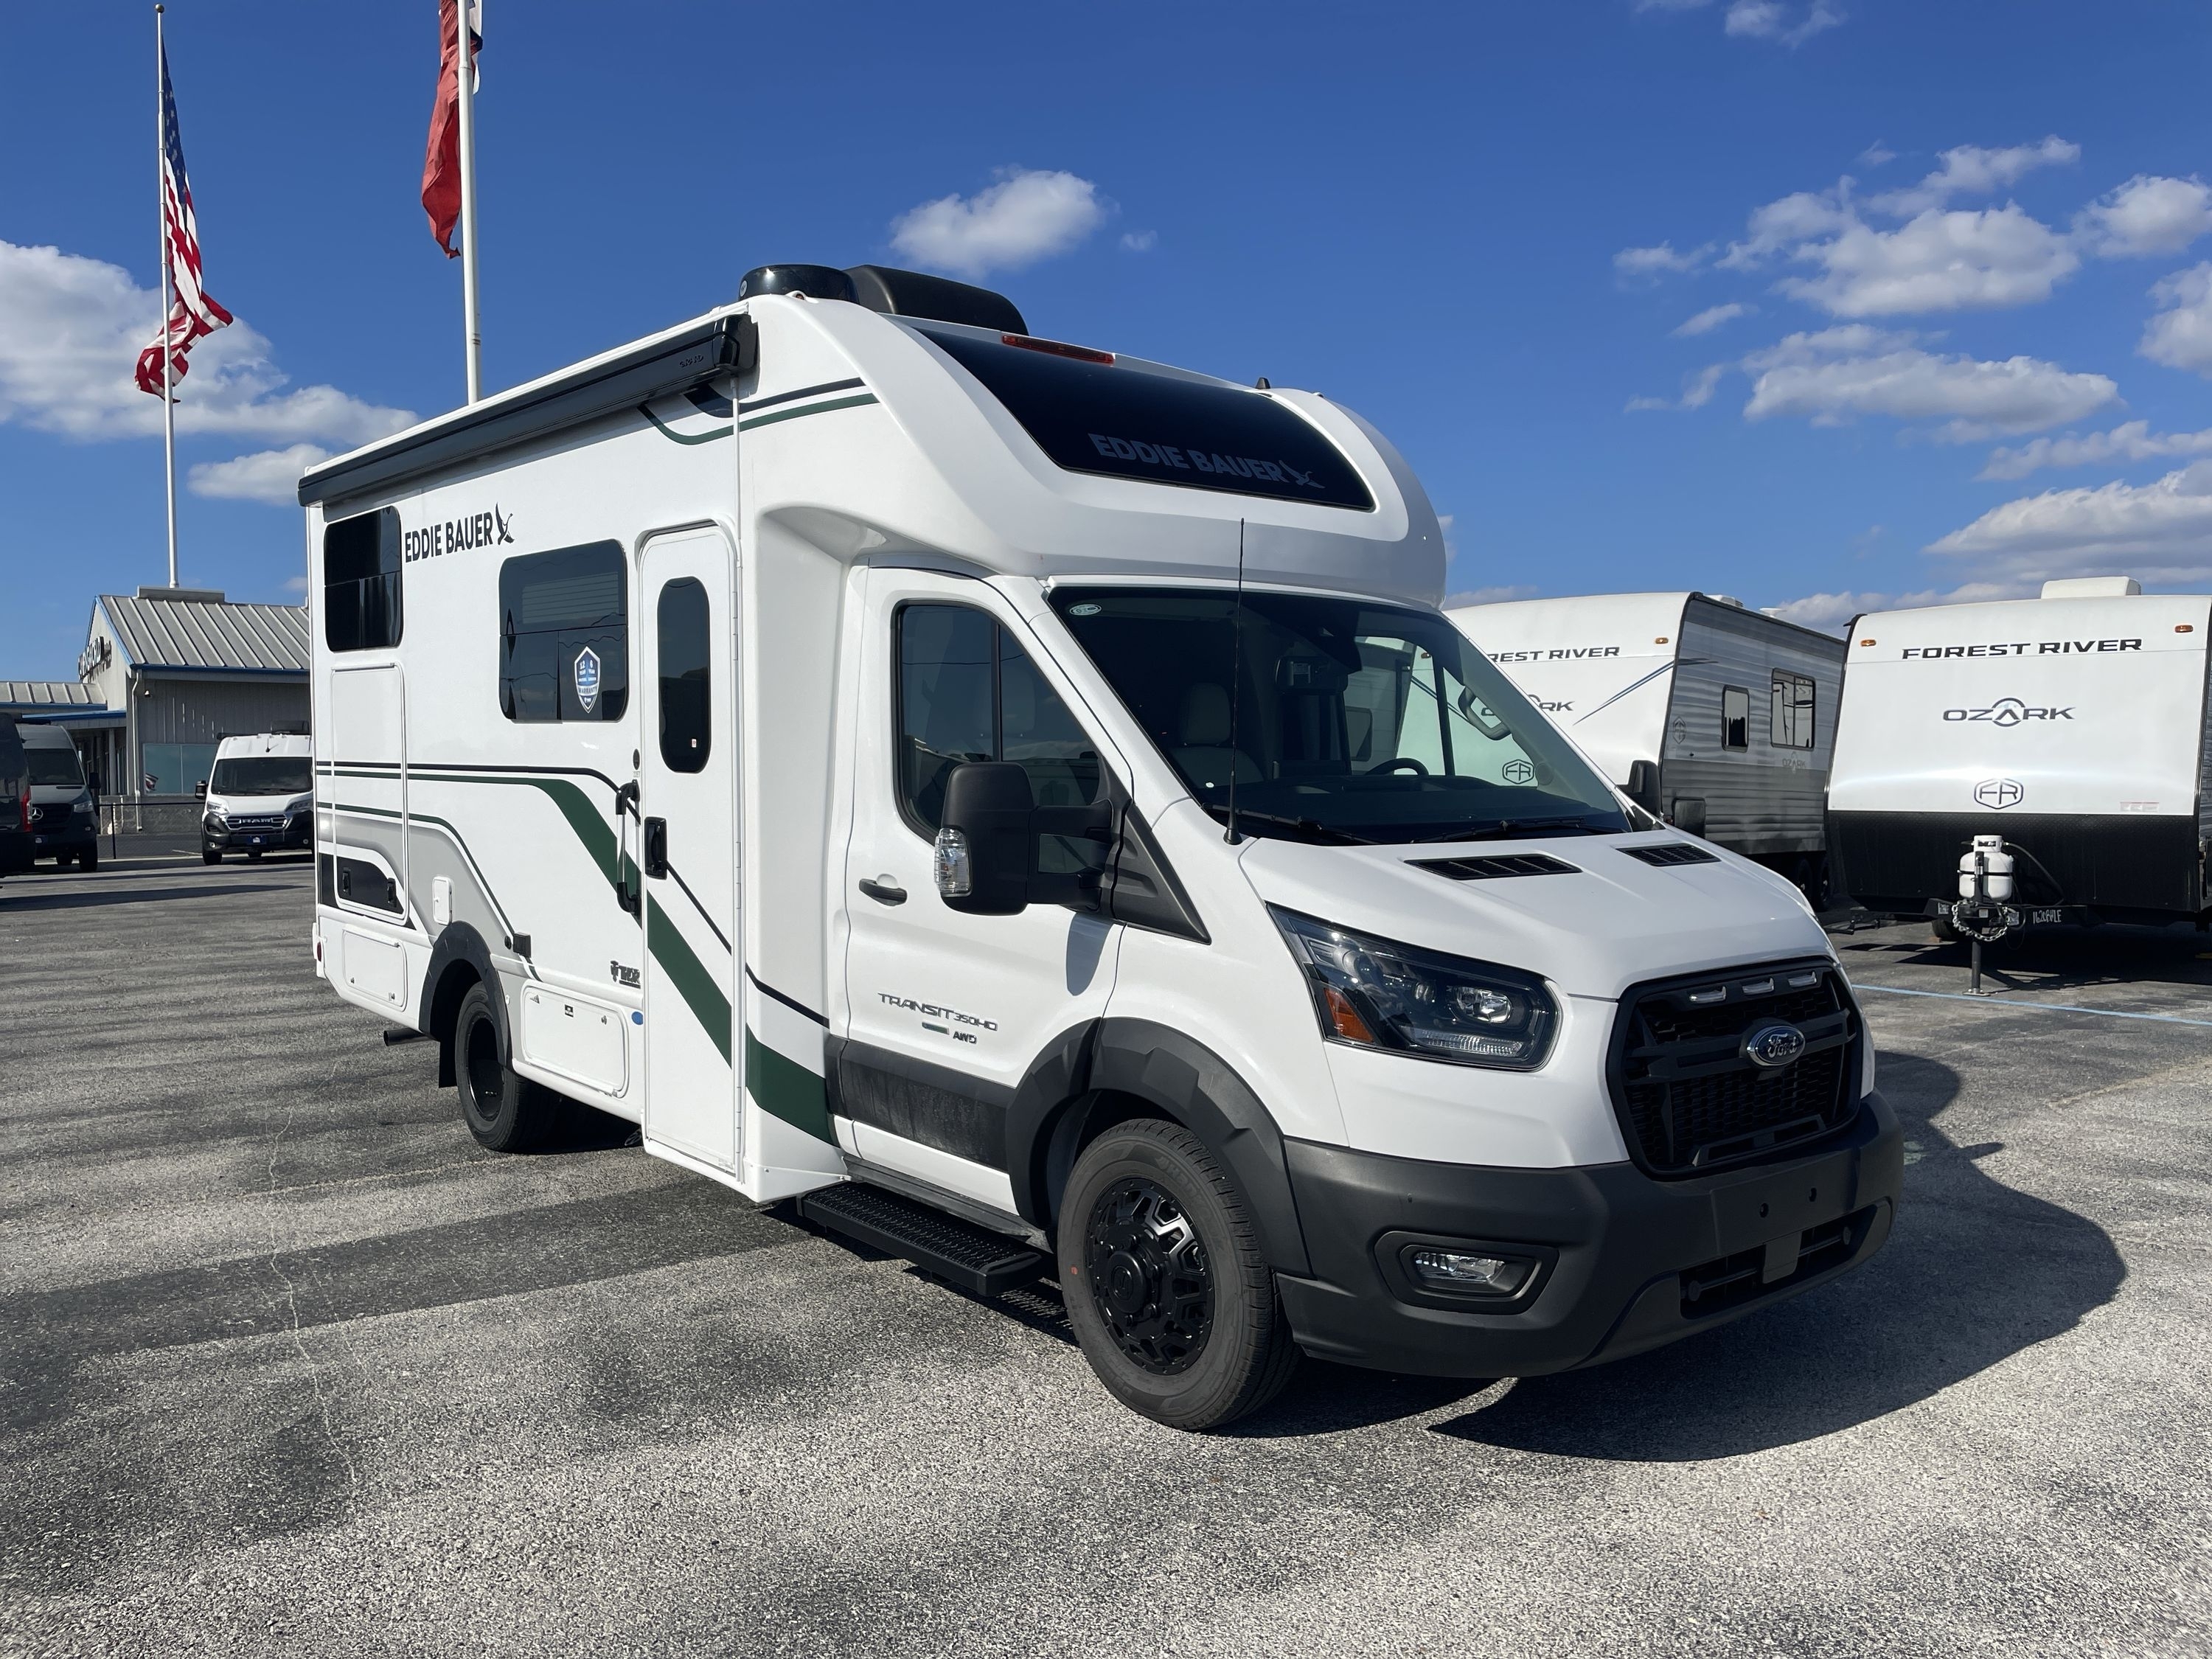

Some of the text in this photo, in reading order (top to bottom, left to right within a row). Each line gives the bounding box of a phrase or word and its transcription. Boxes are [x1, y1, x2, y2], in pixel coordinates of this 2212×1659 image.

[1088, 433, 1289, 483] EDDIE BAUER
[405, 511, 493, 563] EDDIE BAUER
[1487, 647, 1620, 663] REST RIVER
[1902, 639, 2142, 659] FOREST RIVER
[1943, 705, 2076, 723] OZARK
[1506, 762, 1531, 781] FR
[1979, 782, 2018, 805] FR
[877, 992, 998, 1032] TRANSIT 350HD
[953, 1031, 978, 1045] AWD
[1767, 1032, 1798, 1058] Ford
